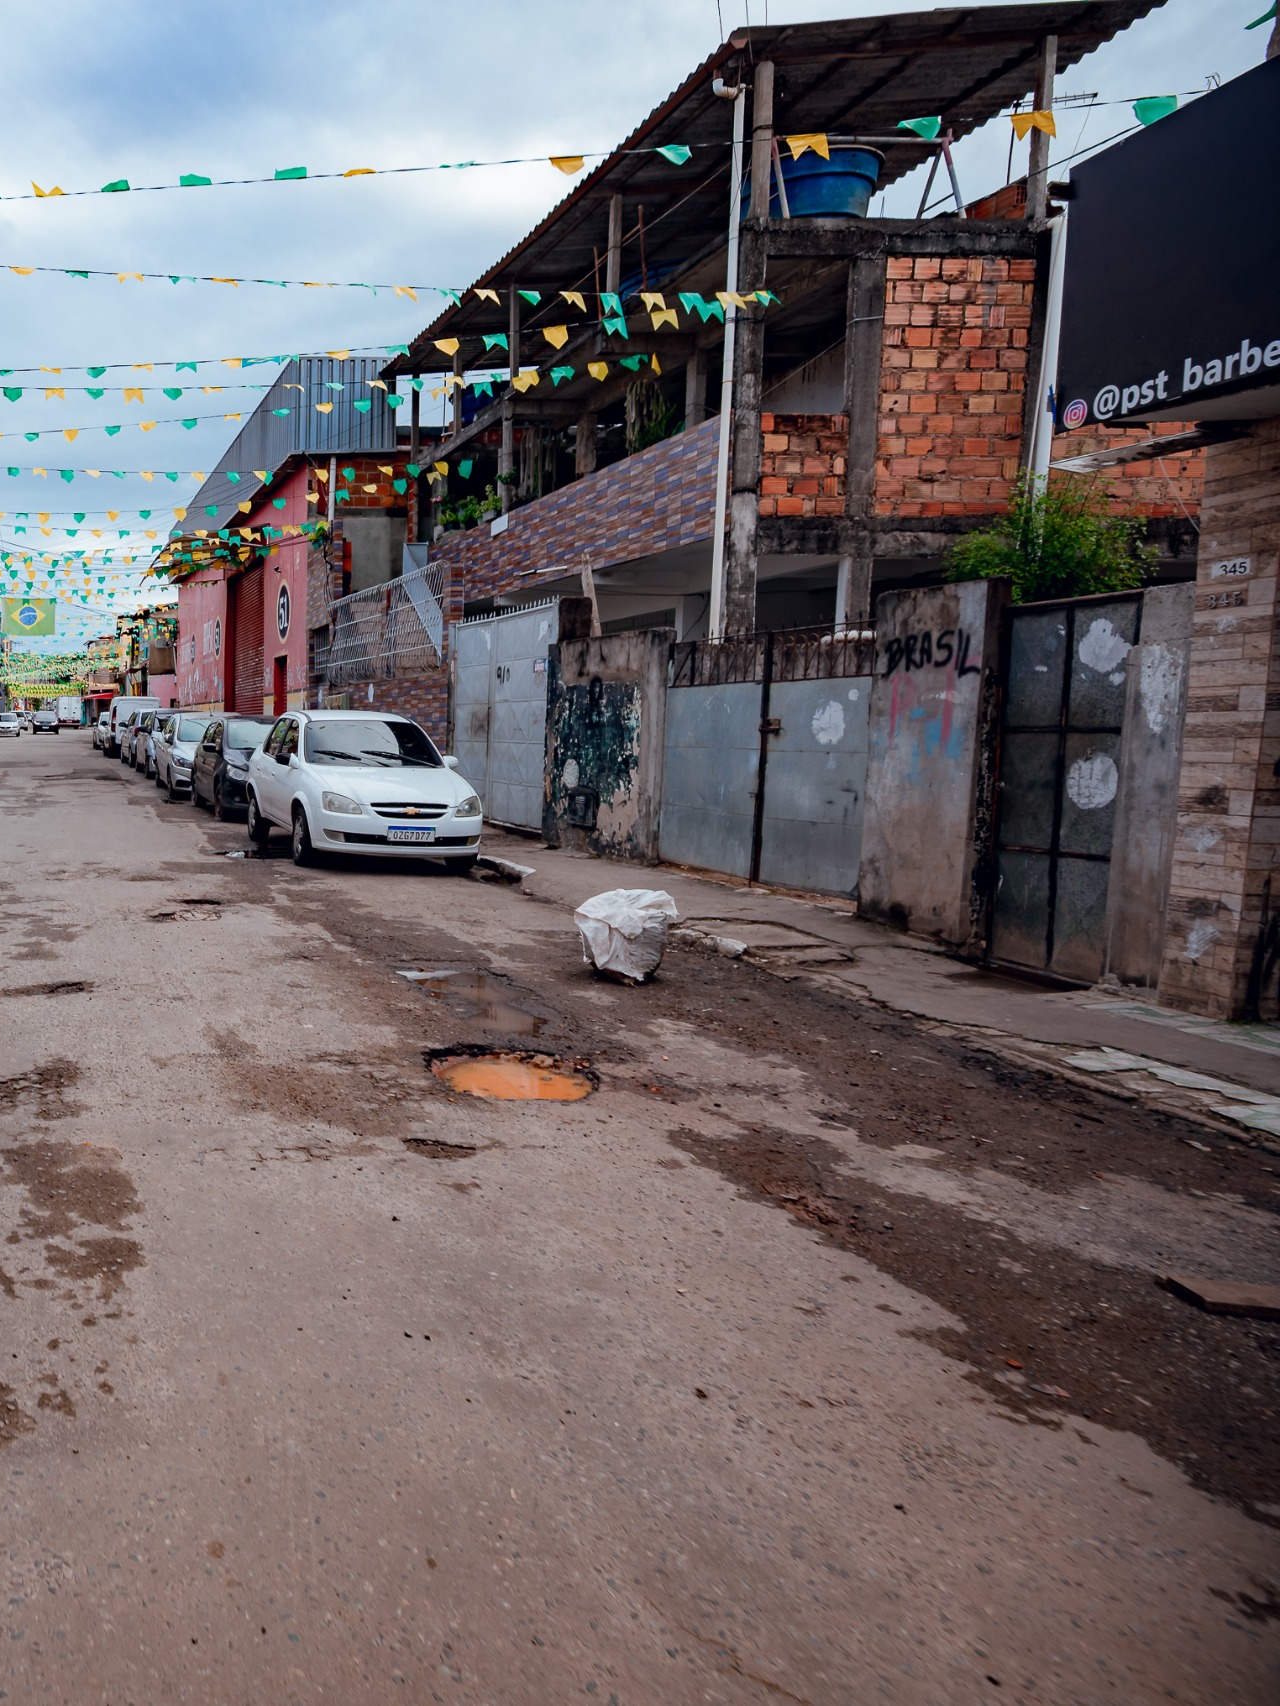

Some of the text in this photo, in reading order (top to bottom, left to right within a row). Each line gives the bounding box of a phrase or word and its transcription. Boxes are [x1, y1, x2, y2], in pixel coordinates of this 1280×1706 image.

[1220, 561, 1247, 575] 345
[279, 594, 289, 631] 51
[1208, 591, 1242, 609] 345
[880, 627, 981, 679] BRASIL
